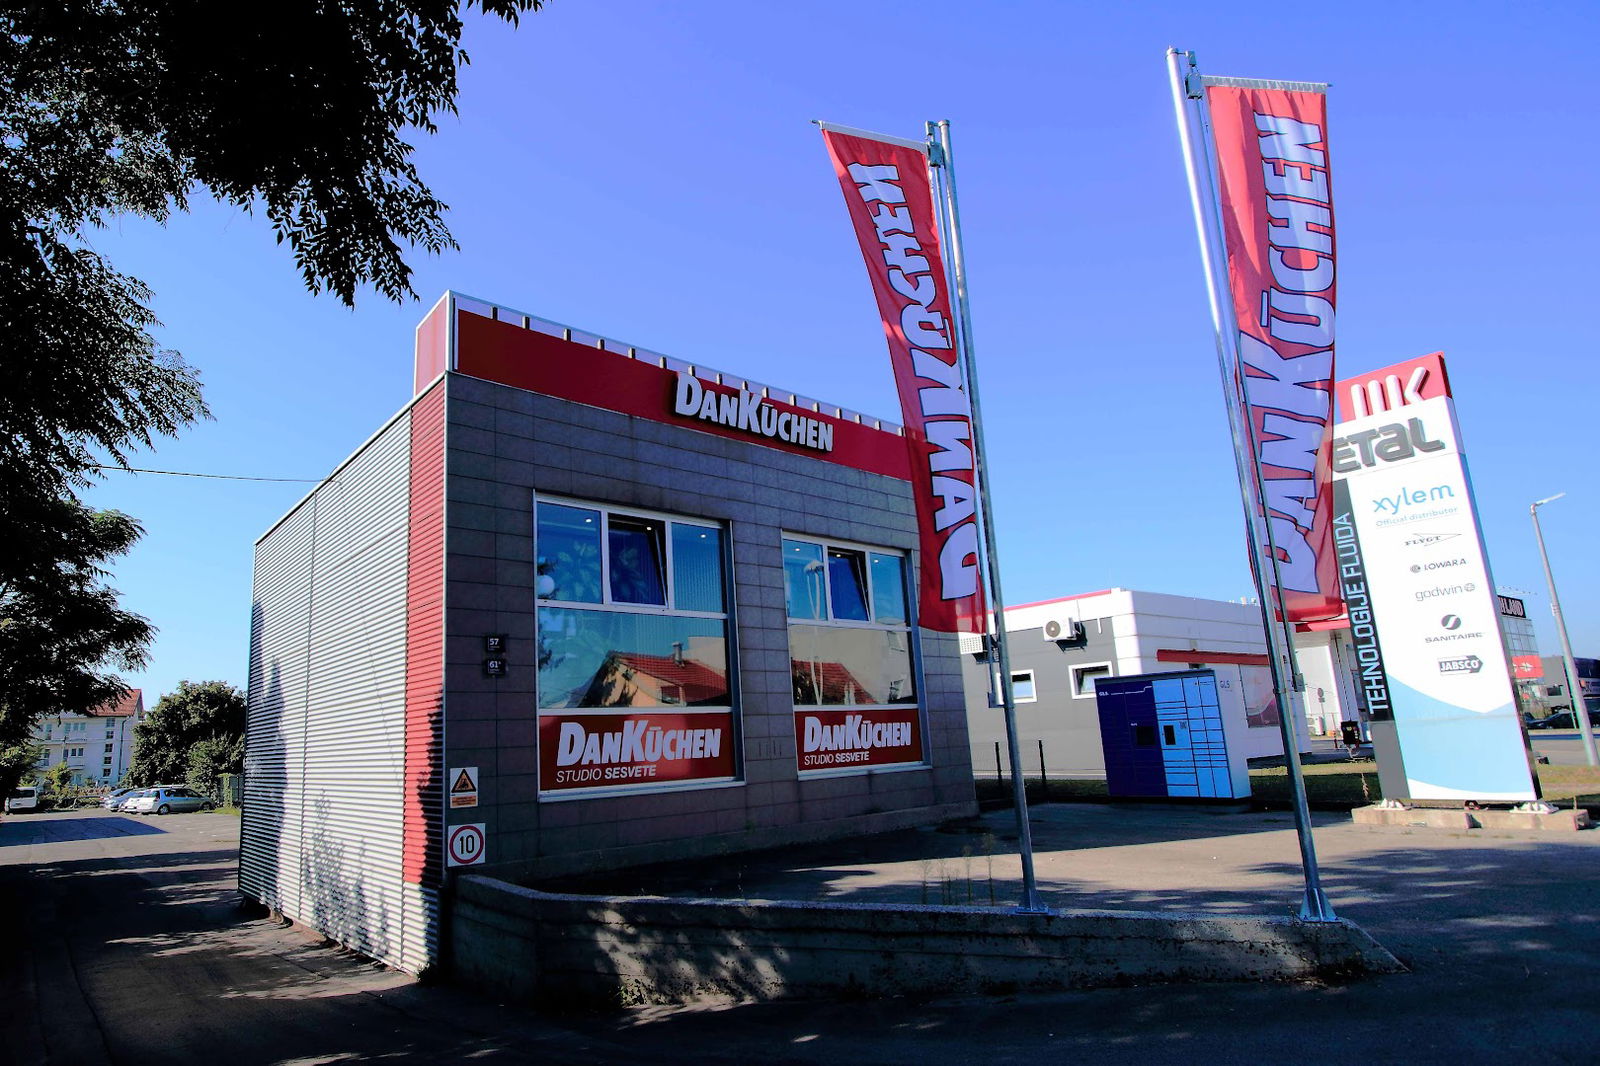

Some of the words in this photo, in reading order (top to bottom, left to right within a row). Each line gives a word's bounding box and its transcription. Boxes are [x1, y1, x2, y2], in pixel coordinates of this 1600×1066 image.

[1372, 485, 1455, 515] xylem
[1376, 516, 1407, 527] Official
[1409, 507, 1458, 520] distributor
[1333, 512, 1363, 578] FLUIDA
[1404, 535, 1441, 546] FLYGT
[1424, 558, 1467, 571] LOWARA
[1415, 585, 1463, 602] godwin
[489, 638, 499, 646] 57
[1424, 632, 1484, 643] SANITAIRE
[1345, 581, 1389, 715] TEHNOLOGIJE
[1440, 660, 1479, 671] JABSCO
[804, 754, 834, 766] STUDIO
[835, 751, 870, 763] SESVETE
[556, 768, 602, 784] STUDIO
[604, 765, 657, 780] SESVETE
[460, 835, 475, 854] 10
